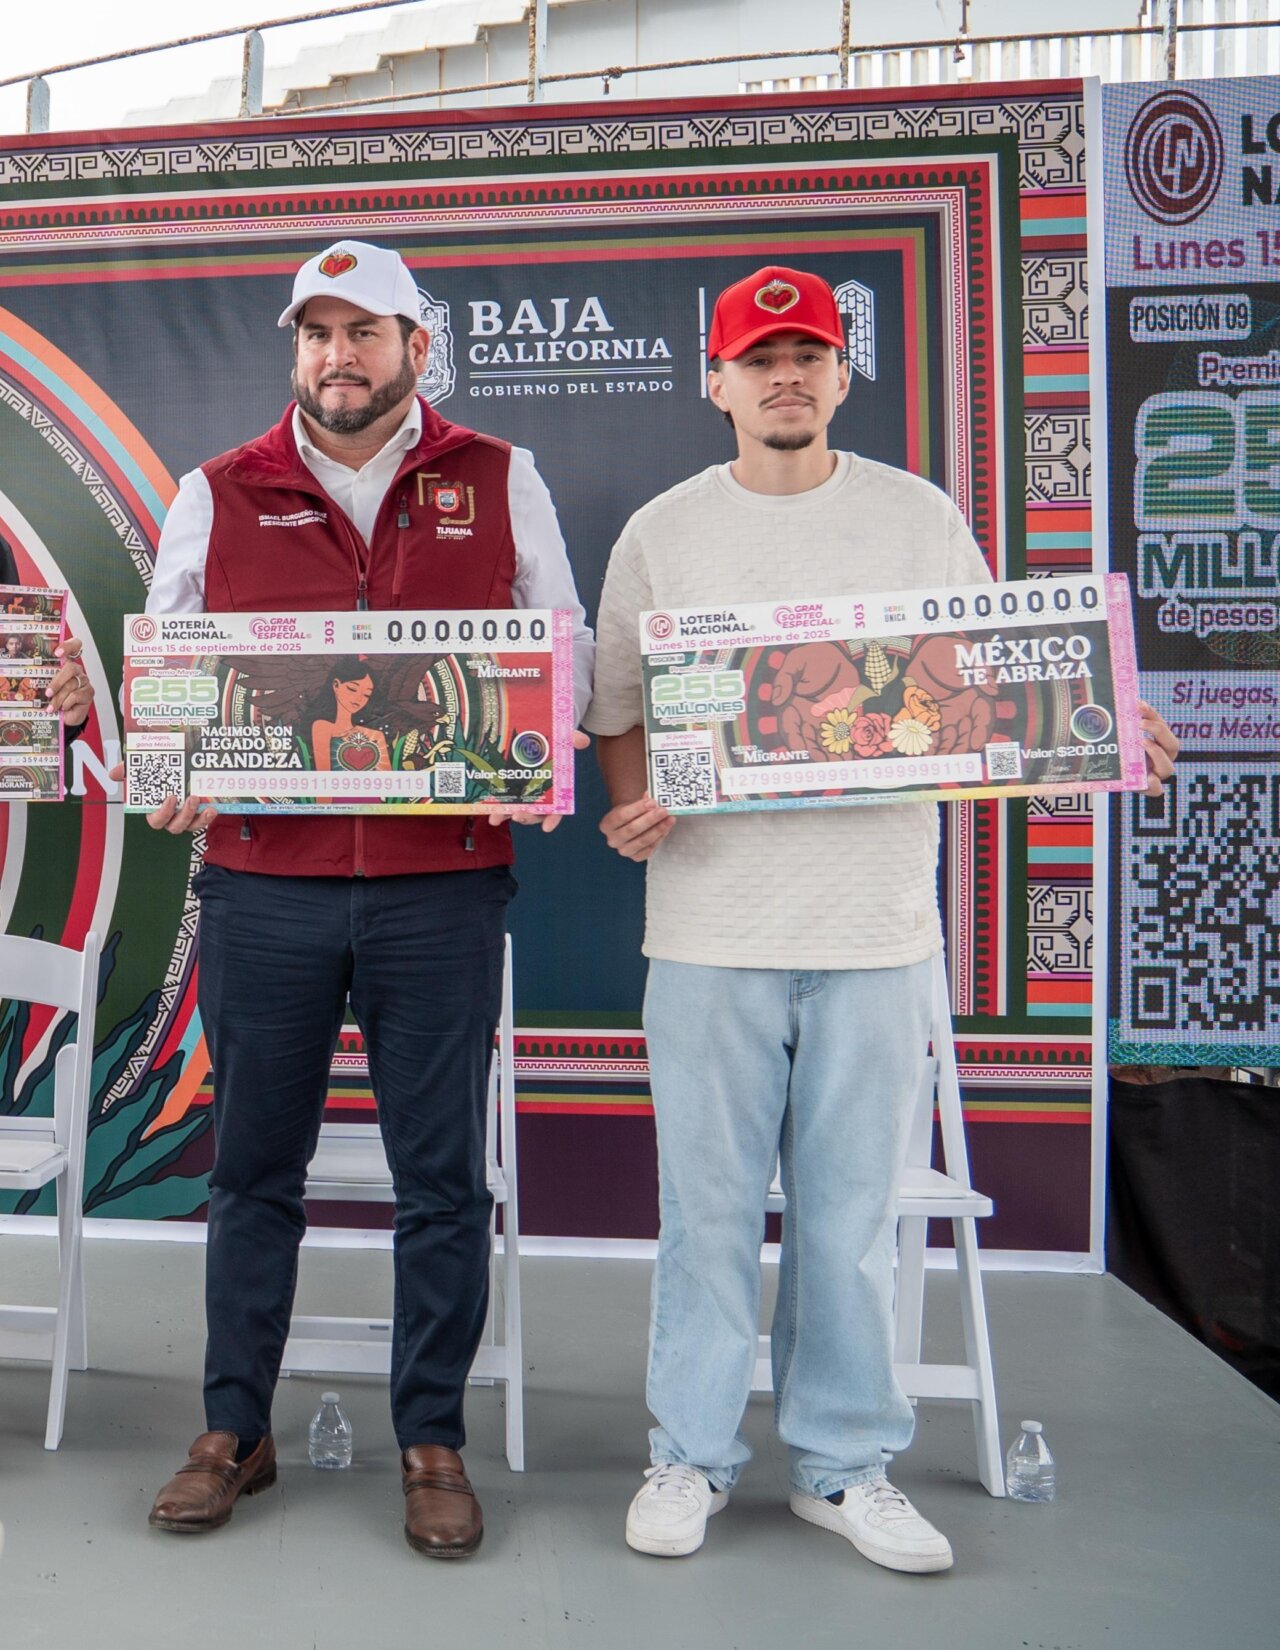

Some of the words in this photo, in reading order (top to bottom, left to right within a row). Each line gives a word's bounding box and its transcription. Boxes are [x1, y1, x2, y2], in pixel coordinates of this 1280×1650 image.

[1132, 235, 1246, 271] Lunes
[468, 296, 614, 340] BAJA
[1133, 299, 1220, 332] POSICIÓN
[1225, 303, 1249, 331] 09
[468, 338, 673, 366] CALIFORNIA
[1202, 355, 1280, 380] Premi
[469, 381, 560, 397] GOBIERNO
[567, 381, 600, 395] DEL
[606, 379, 674, 394] ESTADO
[436, 526, 473, 536] TIJUANA
[1143, 542, 1280, 589] MILL
[781, 612, 824, 622] SORTEO
[795, 605, 823, 613] GRAN
[1162, 603, 1191, 626] de
[1201, 608, 1274, 632] pesos
[162, 618, 216, 630] LOTERÍA
[679, 611, 737, 625] LOTERÍA
[782, 619, 833, 629] ESPECIAL
[162, 631, 226, 640] NACIONAL
[257, 632, 306, 640] ESPECIAL
[324, 620, 335, 645] 303
[680, 624, 750, 636] NACIONAL
[131, 645, 163, 653] Lunes
[179, 644, 192, 652] de
[195, 644, 256, 655] septiembre
[261, 643, 274, 652] de
[276, 643, 301, 651] 2025
[649, 642, 683, 652] Lunes
[685, 640, 696, 649] 15
[700, 638, 714, 648] de
[717, 634, 783, 649] septiembre
[786, 632, 800, 641] de
[804, 630, 831, 640] 2025
[954, 634, 1092, 669] MÉXICO
[959, 669, 987, 686] TE
[996, 661, 1093, 685] ABRAZA
[132, 678, 218, 704] 255
[653, 671, 744, 703] 255
[1172, 680, 1194, 704] Si
[1194, 680, 1278, 709] juegas,
[133, 706, 216, 717] MILLONES
[654, 700, 744, 717] MILLONES
[201, 726, 261, 737] NACIMOS
[264, 726, 293, 737] CON
[1167, 722, 1214, 739] ana
[201, 738, 265, 751] LEGADO
[271, 738, 292, 750] DE
[1021, 748, 1055, 760] Valor
[1057, 744, 1118, 758] $200.00
[191, 752, 303, 769] GRANDEZA
[466, 769, 497, 780] Valor
[498, 769, 552, 780] $200.00
